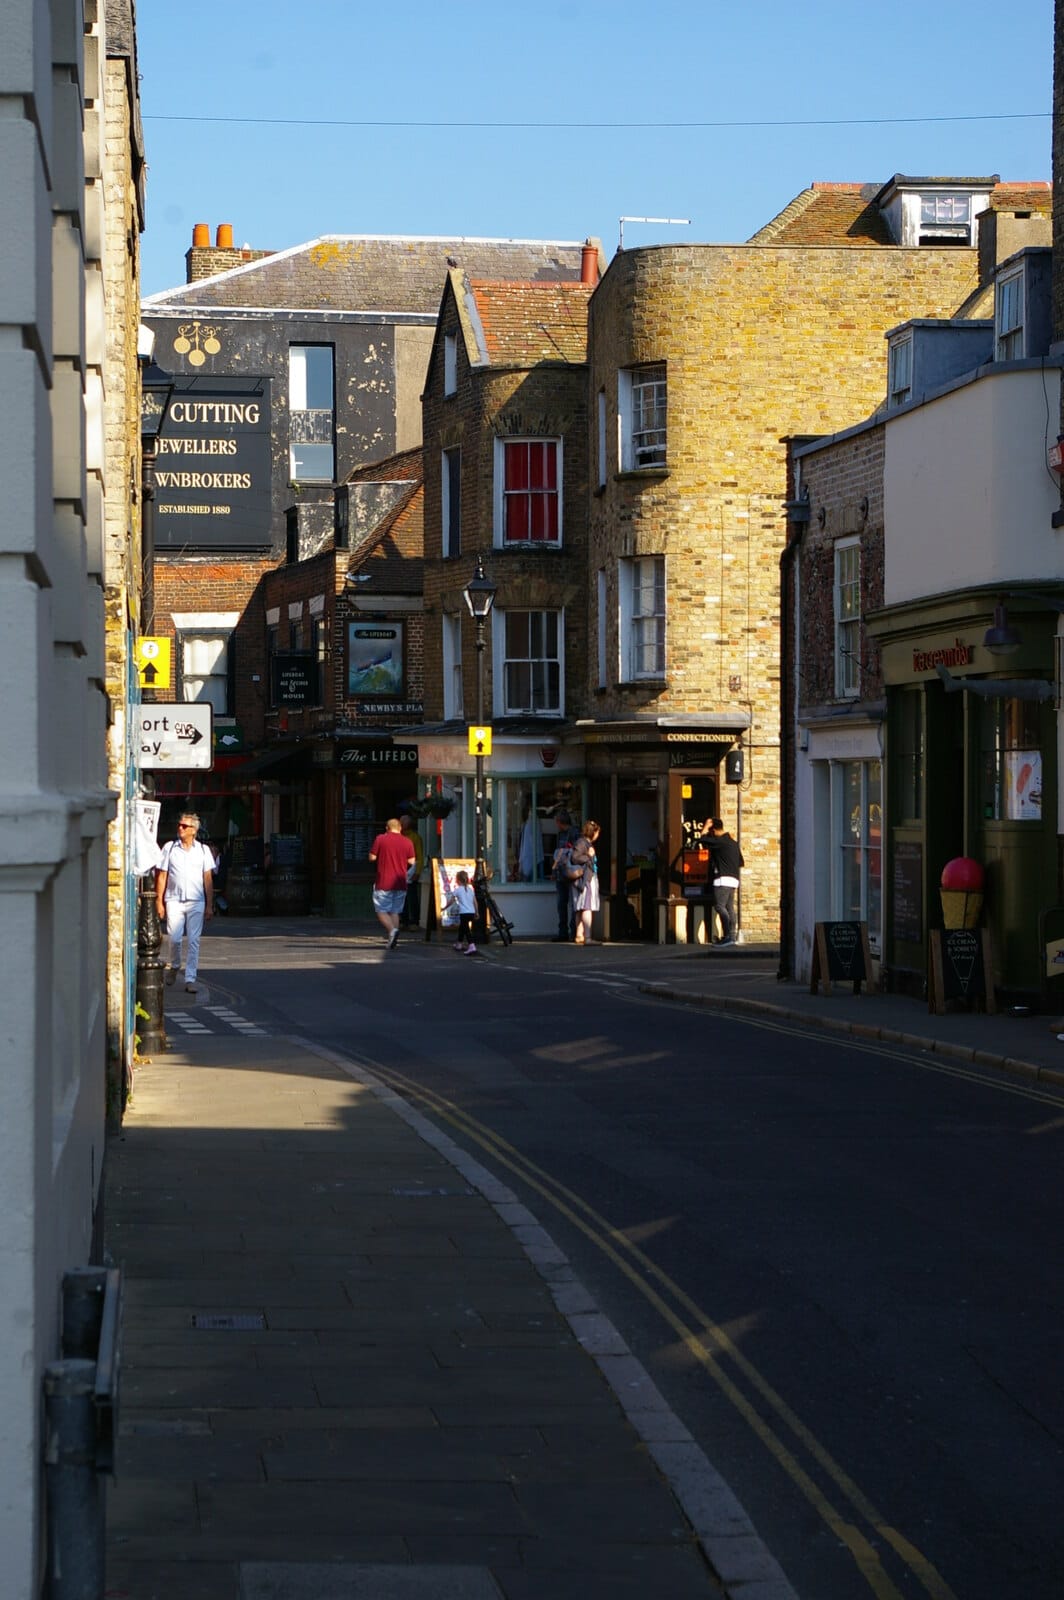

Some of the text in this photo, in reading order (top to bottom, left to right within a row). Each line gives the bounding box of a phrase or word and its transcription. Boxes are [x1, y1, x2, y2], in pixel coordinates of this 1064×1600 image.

[170, 403, 260, 424] CUTTING
[154, 439, 237, 456] JEWELLERS
[154, 472, 251, 489] WNBROKERS
[159, 505, 230, 514] ESTABLISHED 1880
[363, 703, 424, 712] NEWBY'S PLA
[142, 716, 170, 732] ort
[667, 734, 736, 743] CONFECTIONERY
[340, 749, 367, 761] The
[371, 751, 417, 761] LIFEBO
